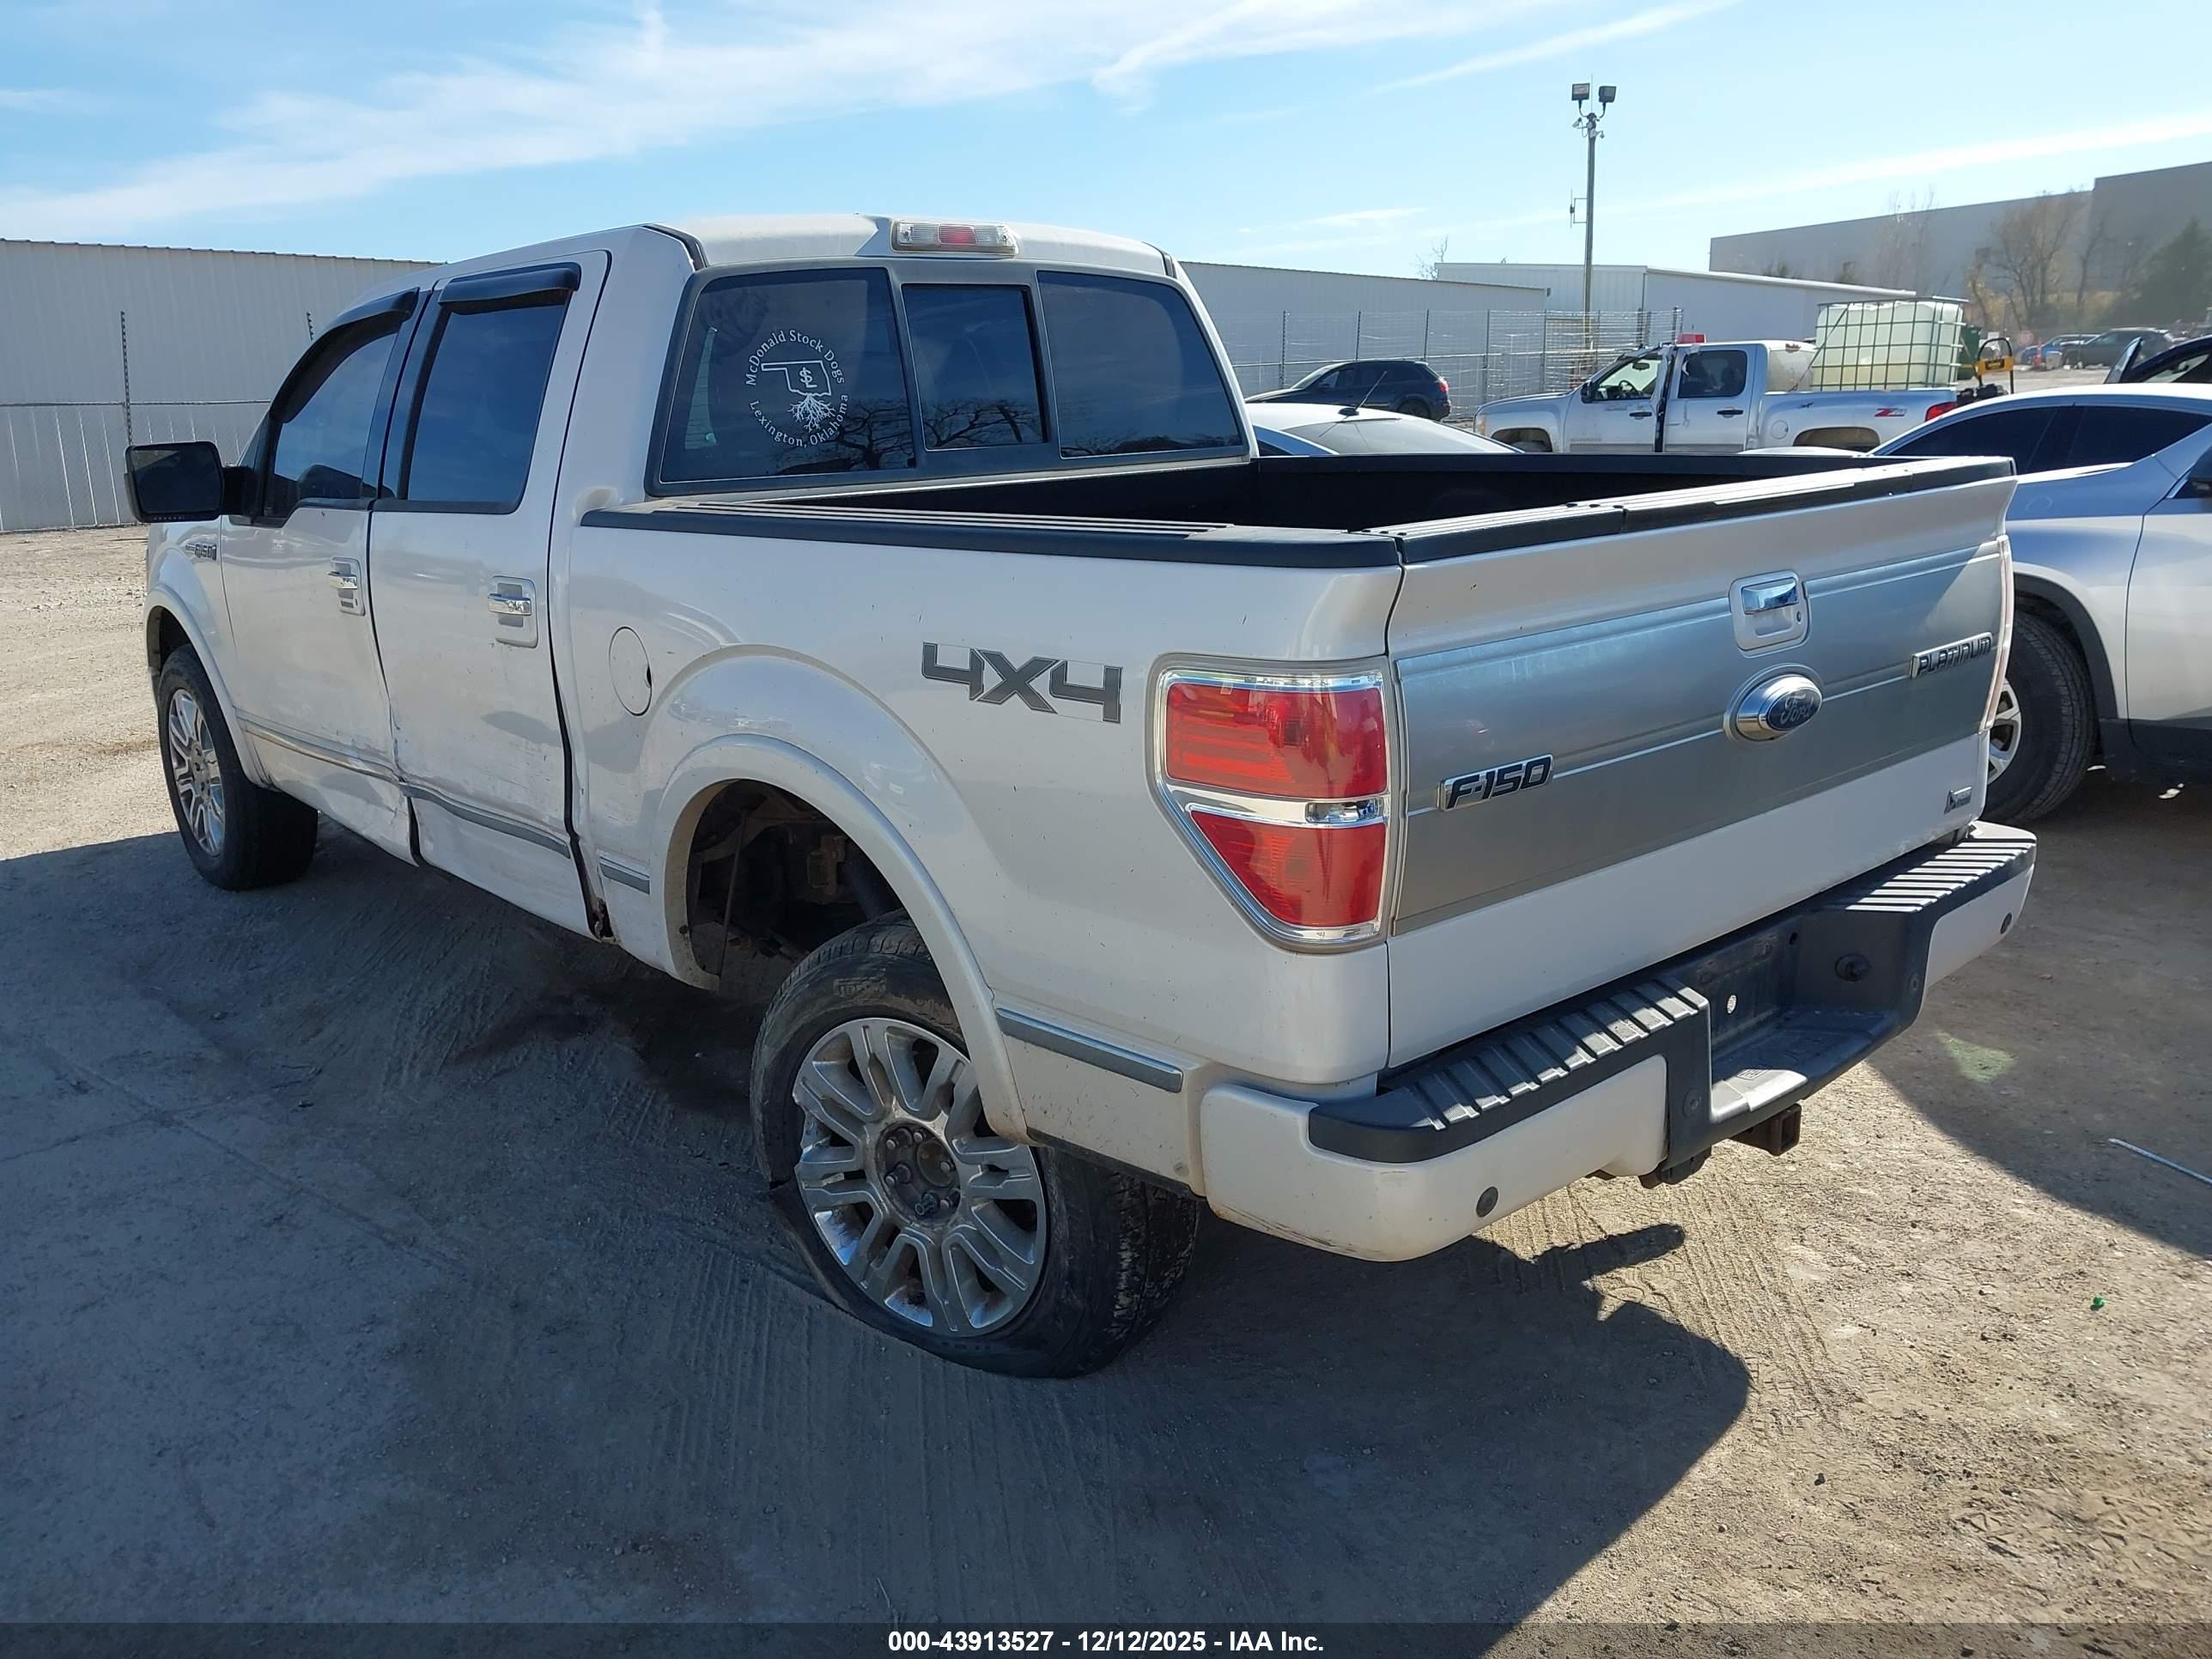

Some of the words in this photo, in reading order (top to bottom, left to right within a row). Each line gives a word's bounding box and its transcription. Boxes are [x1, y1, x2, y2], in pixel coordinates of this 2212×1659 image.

[744, 330, 787, 386] McDonald
[789, 330, 823, 353] Stock
[824, 349, 845, 384] Dogs
[750, 400, 807, 448] Lexington,
[810, 394, 848, 445] Oklahoma
[1918, 636, 1991, 677] PLATINUM
[1780, 693, 1814, 725] Ford
[1446, 756, 1552, 810] F-150
